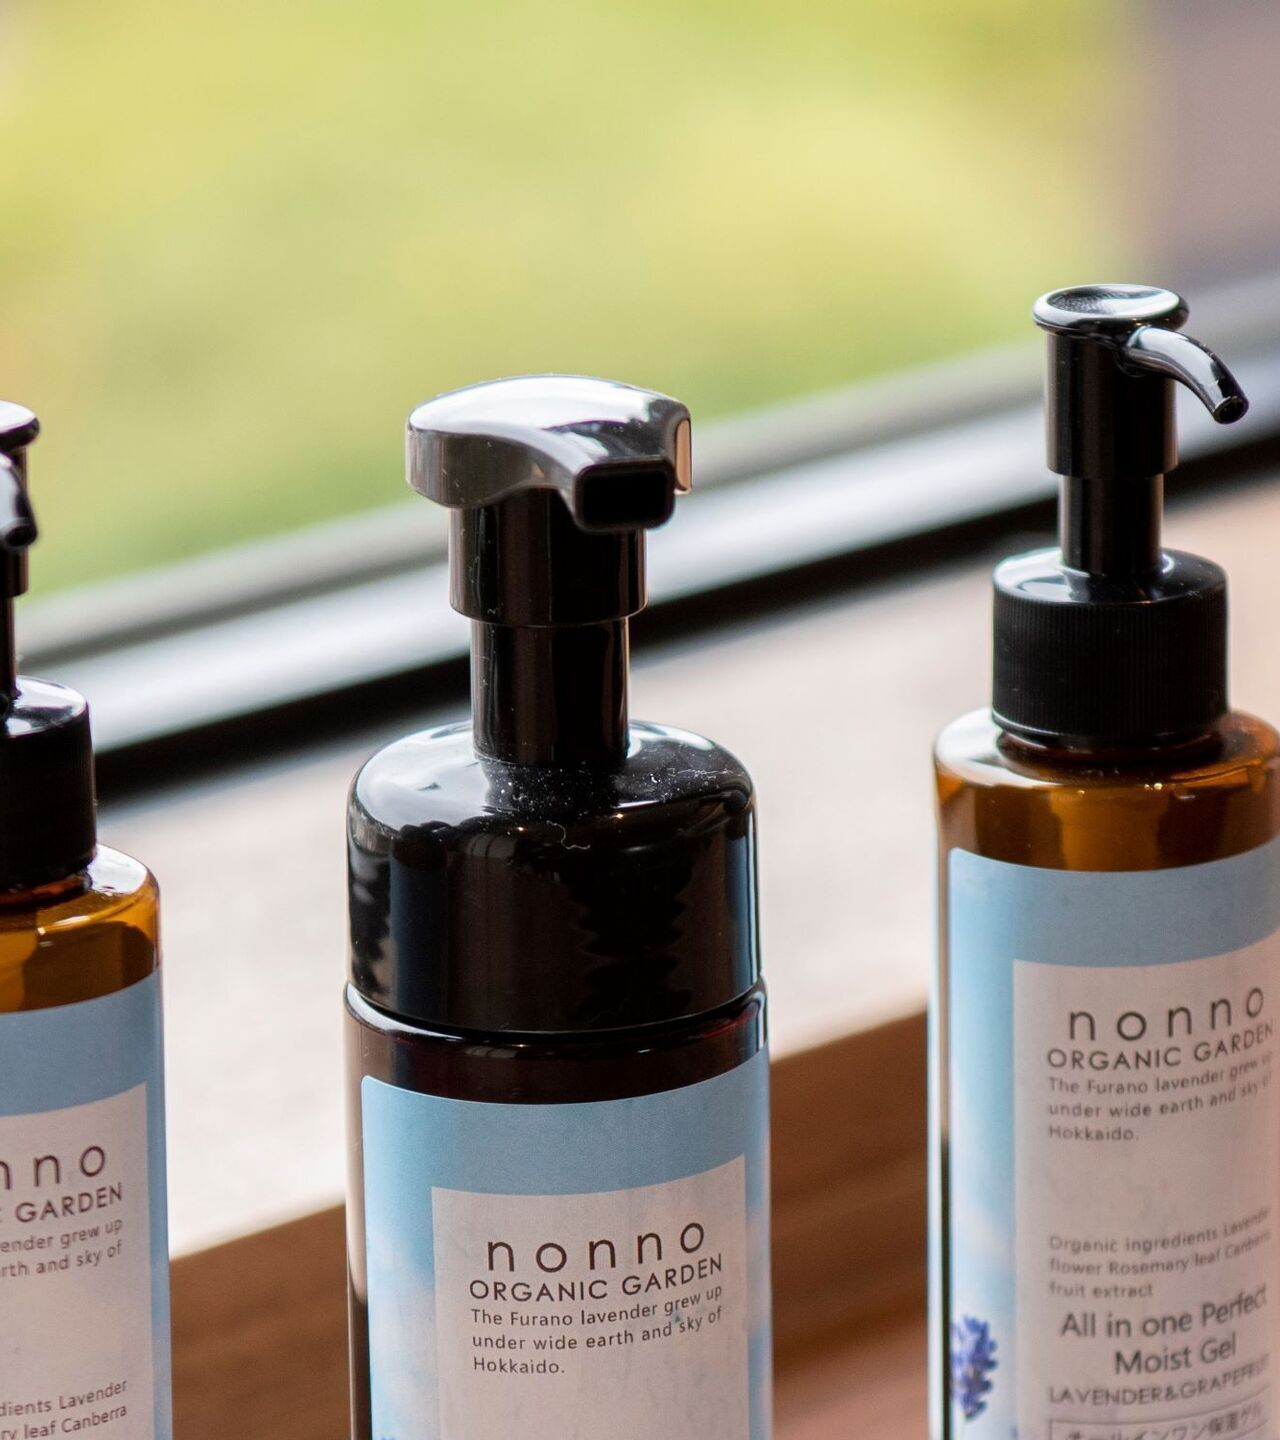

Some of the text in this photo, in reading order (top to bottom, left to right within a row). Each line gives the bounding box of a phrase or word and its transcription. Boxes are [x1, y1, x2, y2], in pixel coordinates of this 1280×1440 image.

[1069, 987, 1264, 1042] nonno
[1047, 1019, 1273, 1071] ORGANIC GARDEN
[1048, 1076, 1079, 1094] The
[1087, 1079, 1148, 1095] Furano
[1155, 1070, 1225, 1092] lavender
[1047, 1102, 1101, 1118] under
[1109, 1102, 1152, 1117] wide
[1159, 1096, 1204, 1116] earth
[1209, 1087, 1236, 1108] and
[1047, 1124, 1139, 1141] Hokkaido.
[15, 1182, 123, 1222] GARDEN
[60, 1225, 100, 1249] grew
[105, 1218, 124, 1239] up
[487, 1222, 704, 1273] nonno
[1048, 1235, 1118, 1255] Organic
[1125, 1228, 1218, 1255] ingredients
[36, 1256, 69, 1275] and
[76, 1247, 101, 1269] sky
[107, 1240, 123, 1259] of
[1049, 1257, 1102, 1276] flower
[1108, 1256, 1190, 1275] Rosemary
[1194, 1246, 1221, 1267] leaf
[469, 1253, 723, 1302] ORGANIC GARDEN
[1049, 1282, 1153, 1298] fruit extract
[471, 1285, 723, 1327] The Furano lavender grew up
[1061, 1283, 1267, 1338] All in one Perfect
[472, 1305, 723, 1350] under wide earth and sky of
[473, 1356, 566, 1374] Hokkaido.
[1114, 1332, 1237, 1376] Moist Gel
[58, 1380, 127, 1410] Lavender
[23, 1420, 57, 1439] leaf
[61, 1405, 127, 1434] Canberra
